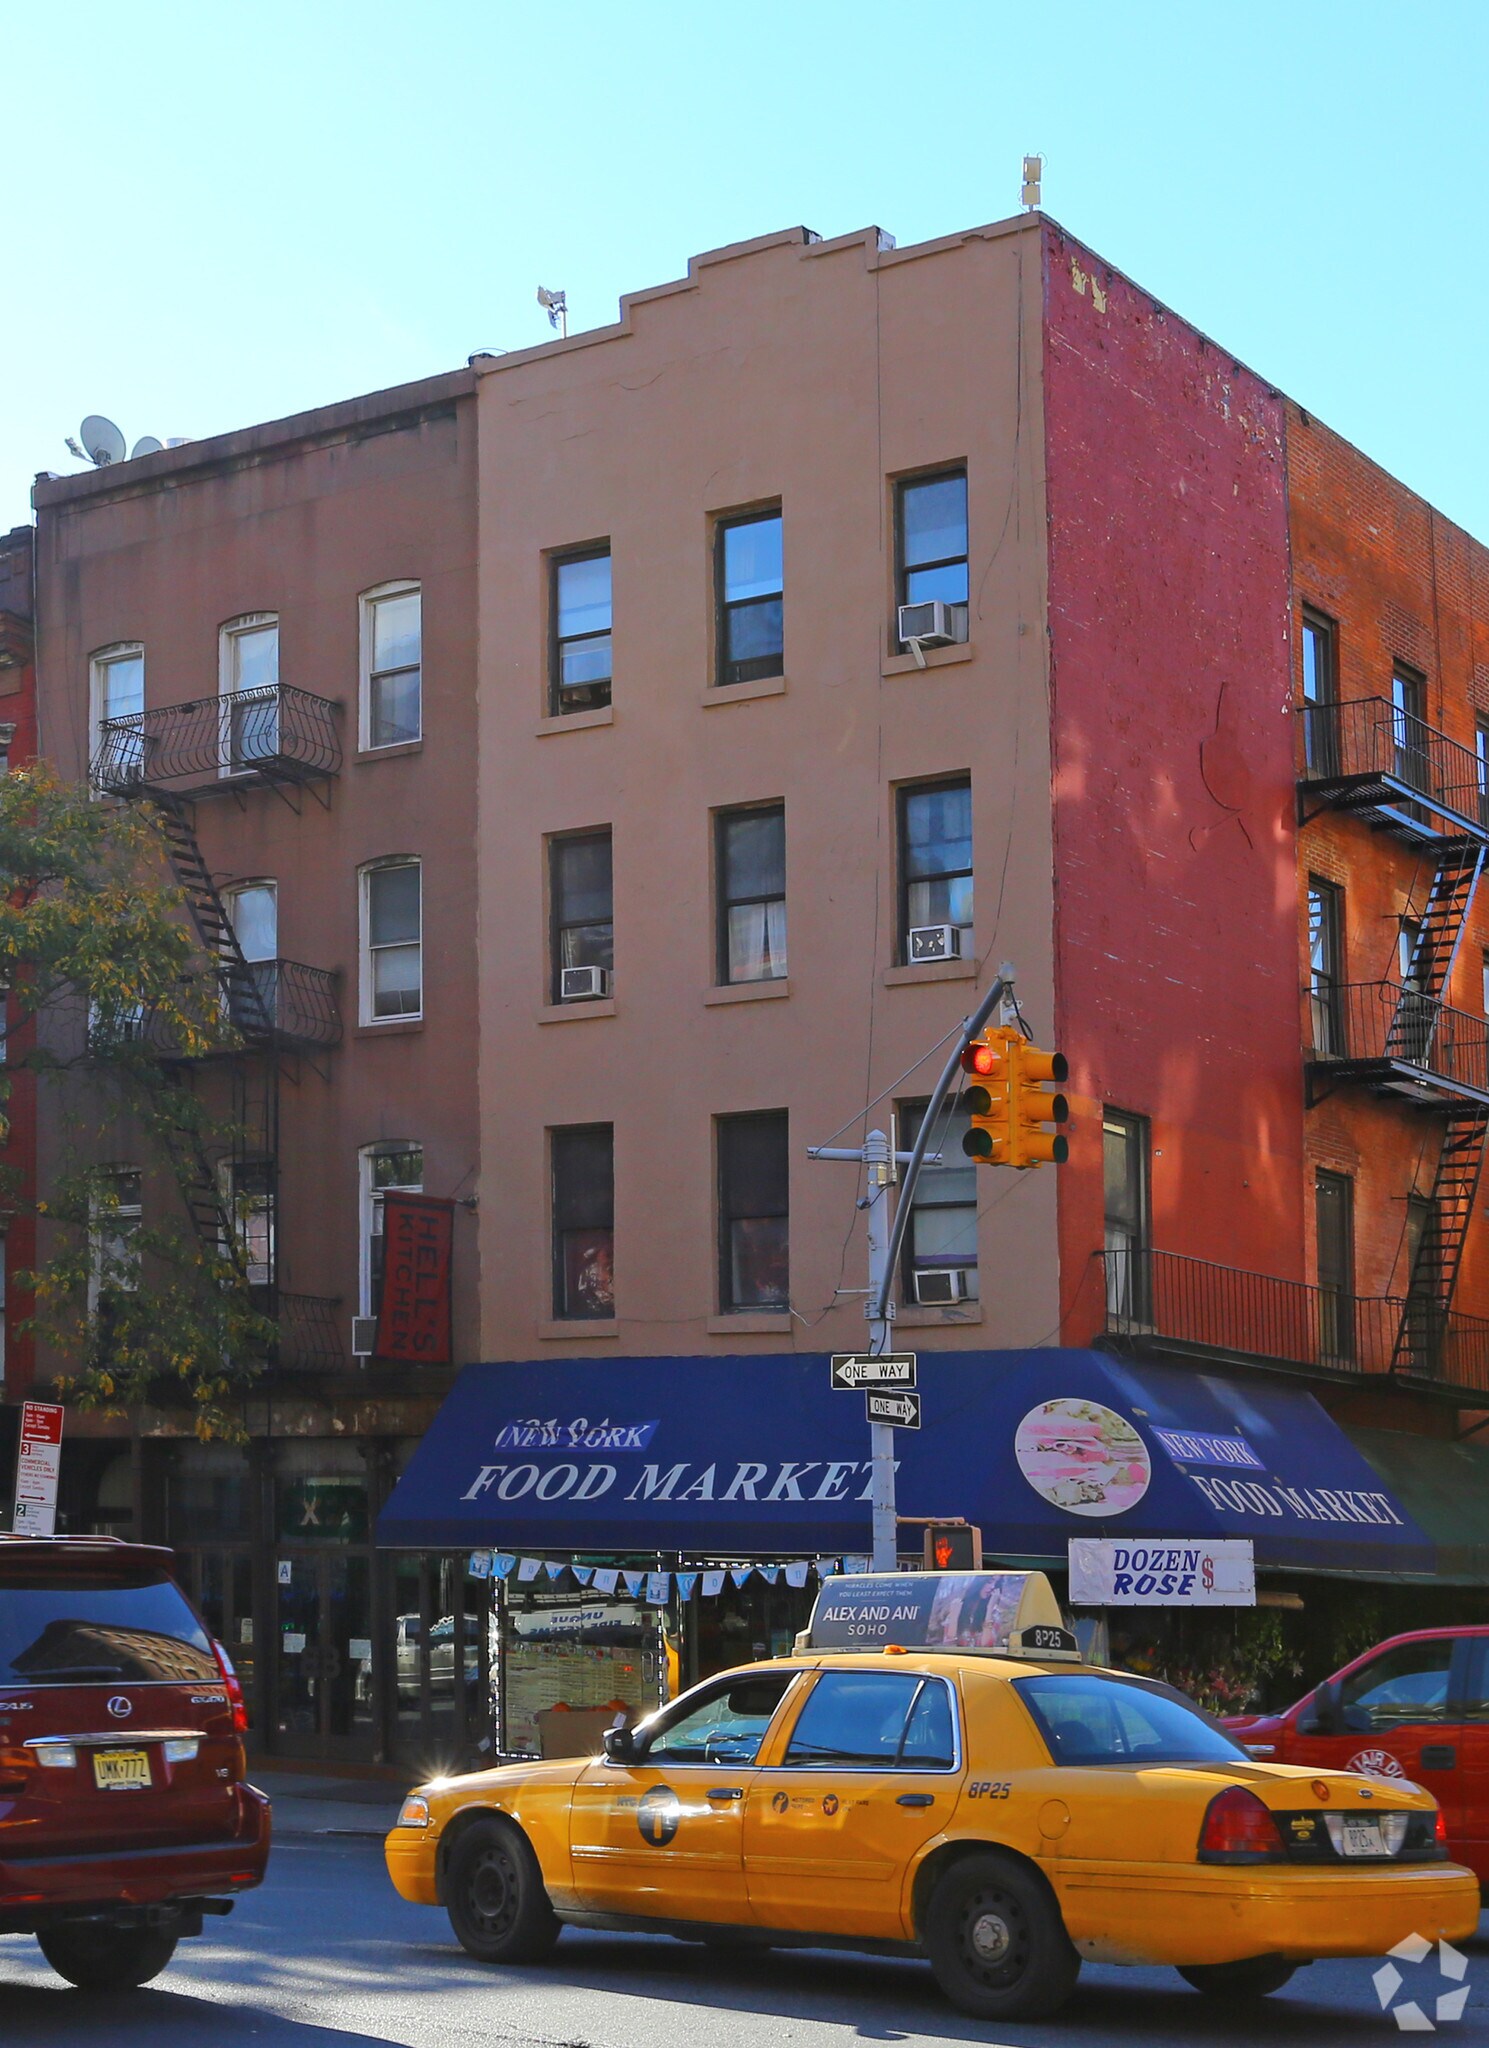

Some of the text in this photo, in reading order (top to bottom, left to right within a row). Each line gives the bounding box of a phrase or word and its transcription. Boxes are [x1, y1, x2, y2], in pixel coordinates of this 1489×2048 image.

[392, 1213, 413, 1350] KITCHEN
[413, 1215, 438, 1352] HELL'S
[844, 1364, 904, 1379] ONE WAY
[874, 1399, 912, 1416] ONE WAY
[501, 1425, 651, 1448] NEW YORK
[22, 1443, 29, 1455] 3
[1156, 1431, 1260, 1466] NEW YORK
[459, 1464, 617, 1501] FOOD
[1190, 1475, 1405, 1525] FOOD MARKET
[1113, 1548, 1201, 1572] DOZEN
[279, 1564, 289, 1578] A
[1113, 1573, 1197, 1595] ROSE
[823, 1605, 919, 1621] ALEX AND ANI
[847, 1624, 887, 1636] SOHO
[1035, 1629, 1062, 1648] 8P25
[968, 1781, 1012, 1799] 8P25
